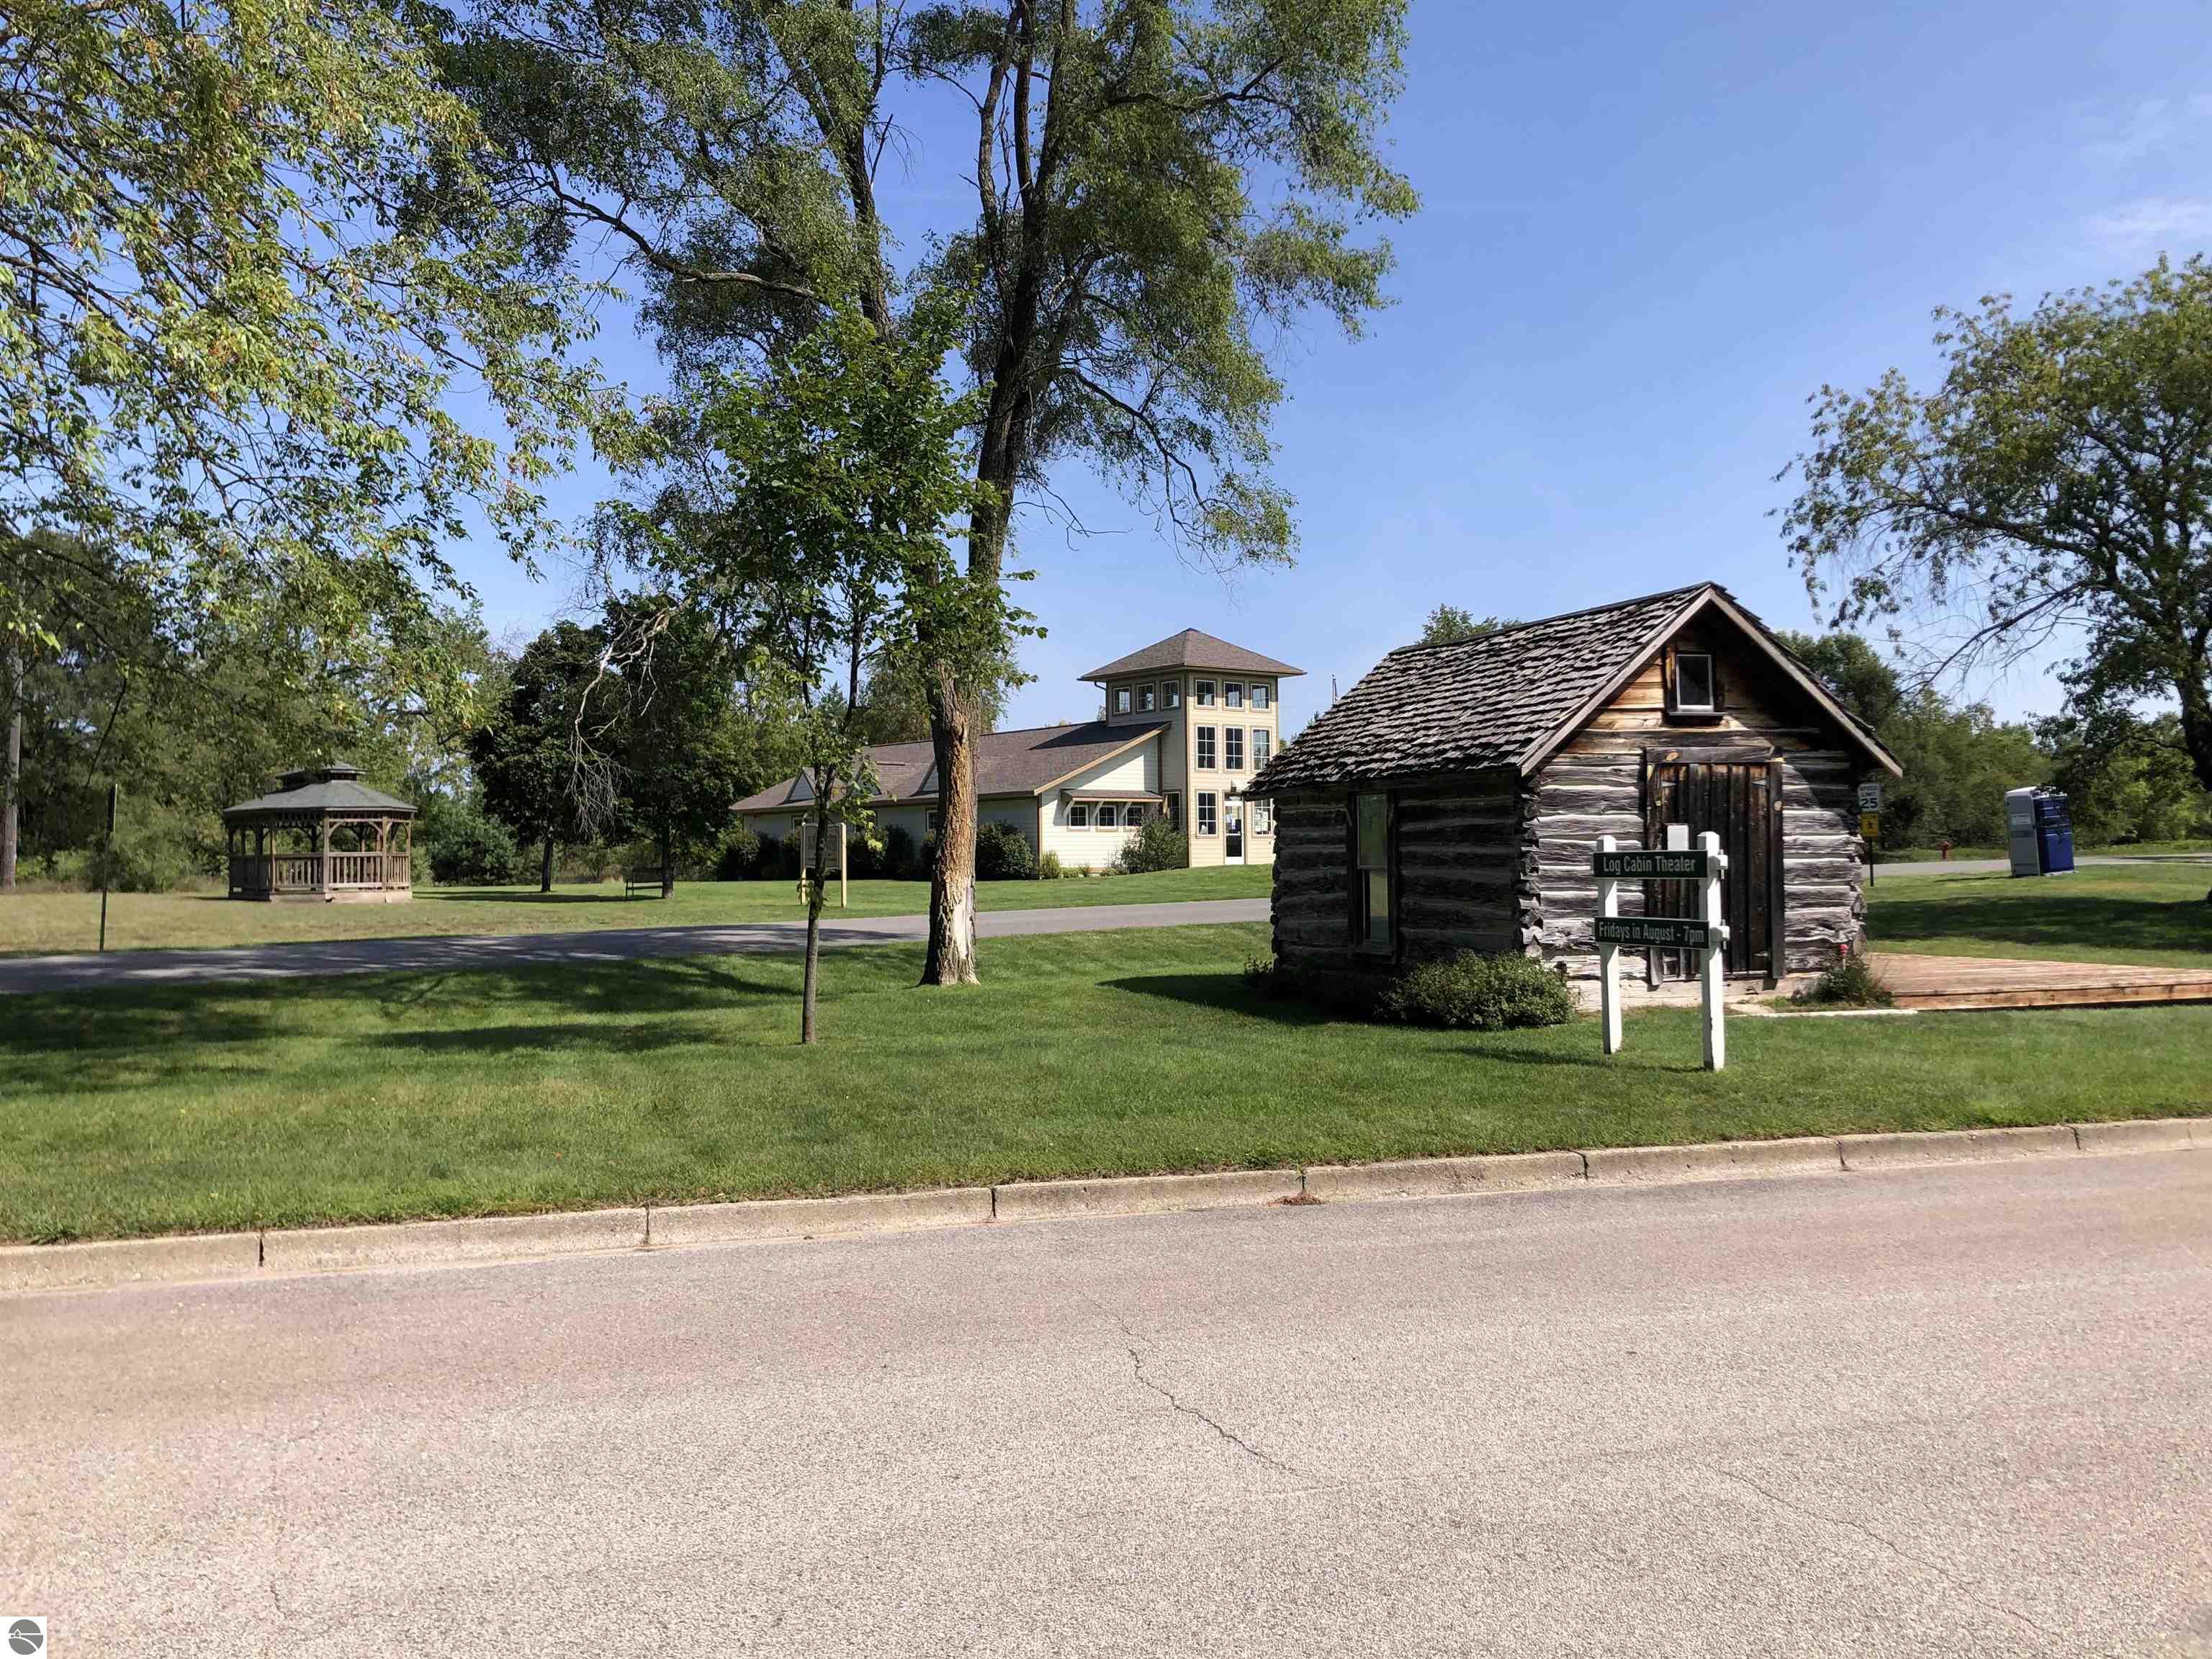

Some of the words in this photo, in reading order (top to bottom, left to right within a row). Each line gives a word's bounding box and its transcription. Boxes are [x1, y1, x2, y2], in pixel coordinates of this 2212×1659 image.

[1861, 798, 1878, 809] 25
[1603, 856, 1620, 875] Log
[1624, 855, 1652, 872] Cabin
[1655, 855, 1696, 872] Theater
[1599, 922, 1629, 941] Fridays
[1632, 923, 1640, 939] in
[1643, 924, 1675, 943] August
[1683, 925, 1705, 945] 7pm
